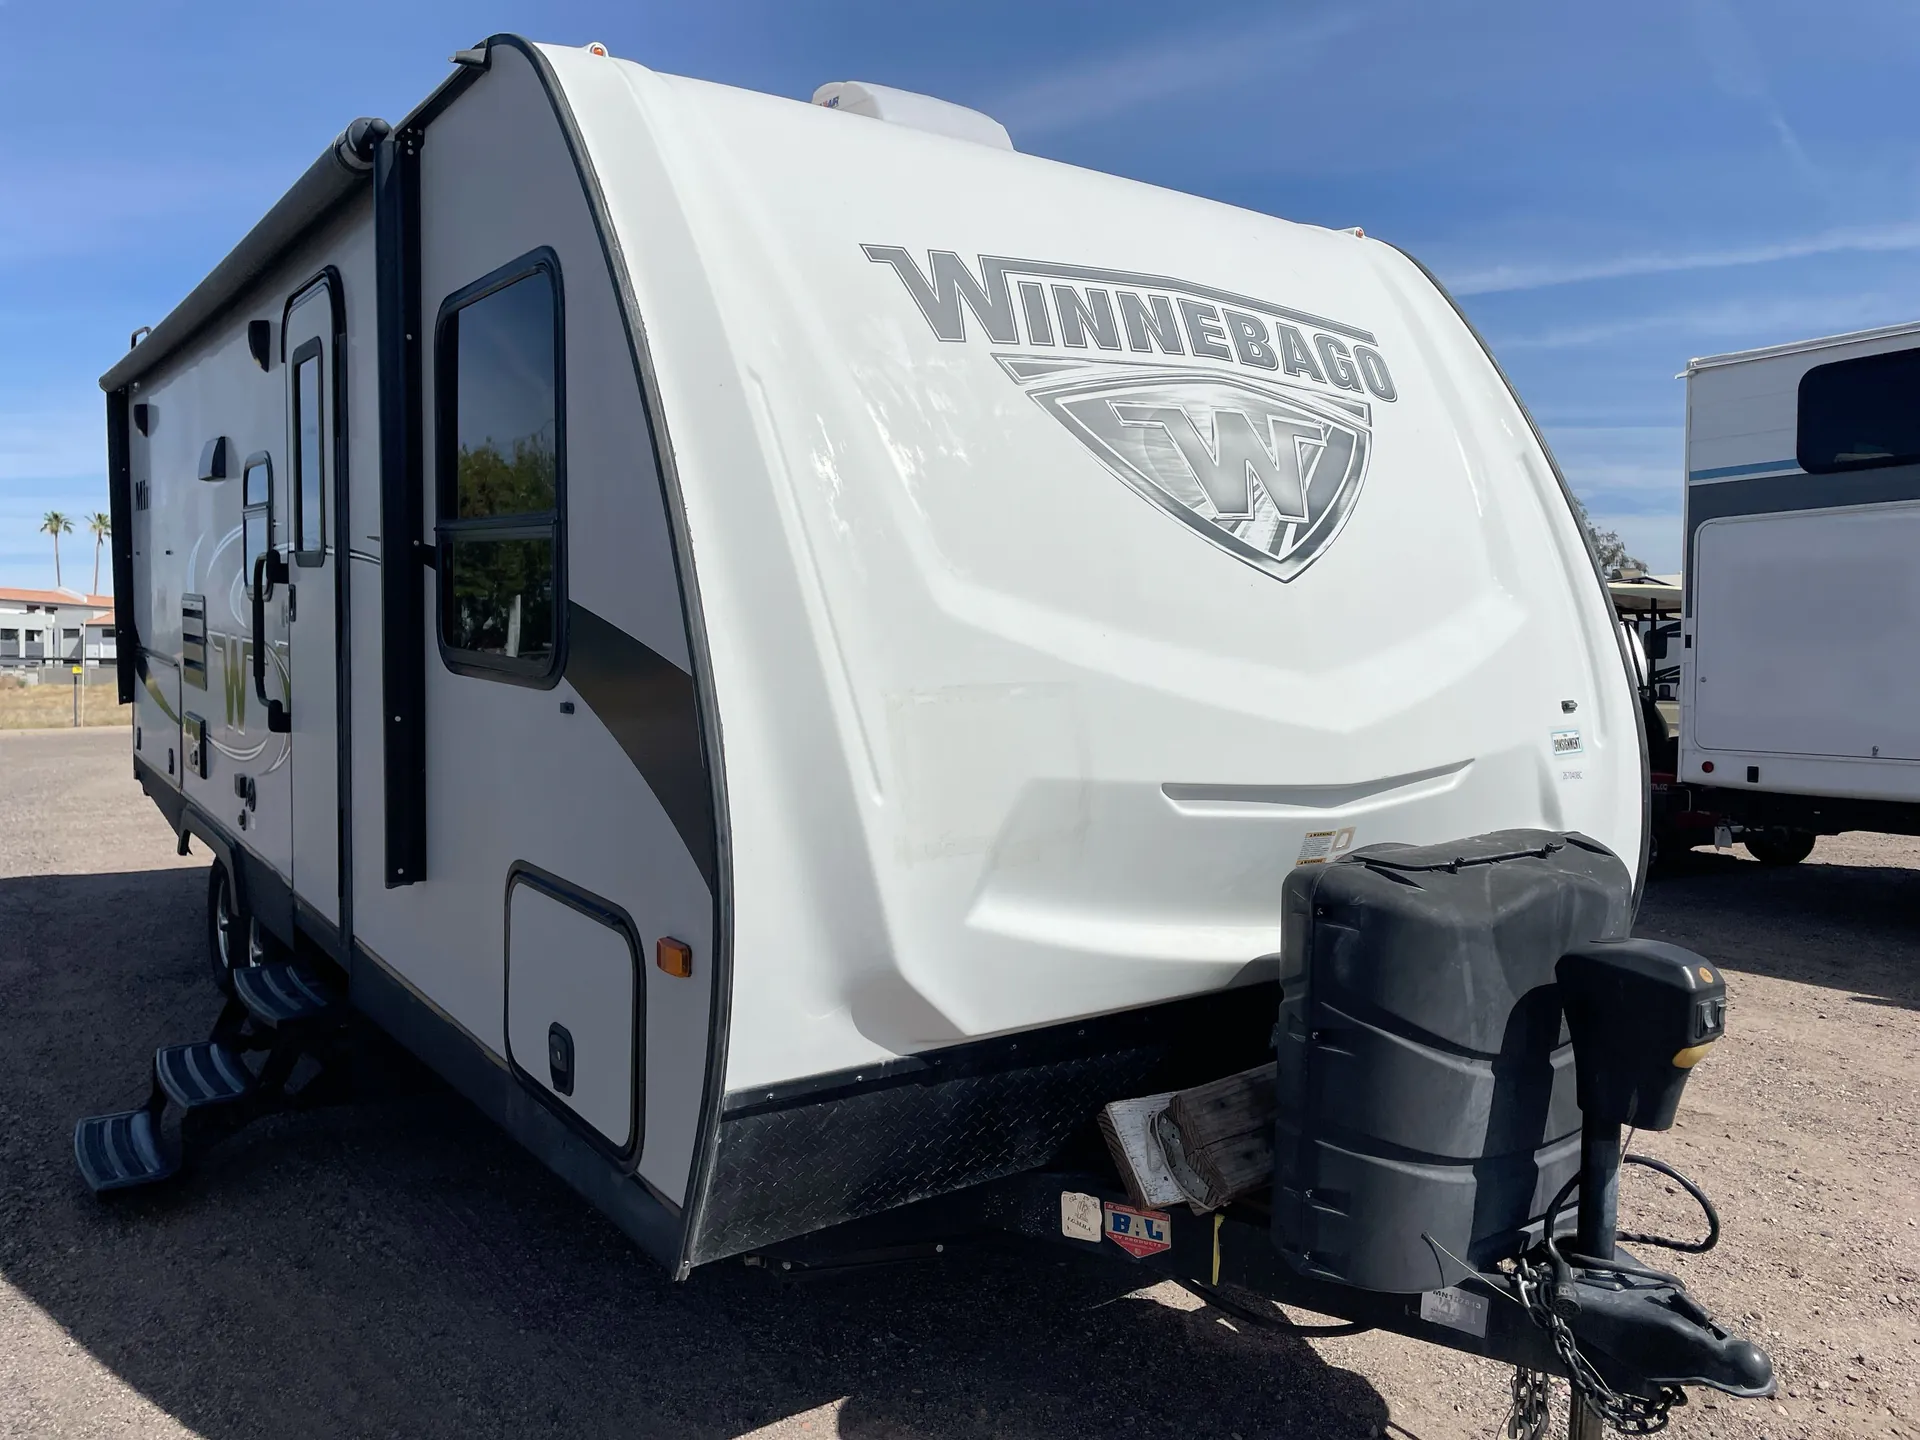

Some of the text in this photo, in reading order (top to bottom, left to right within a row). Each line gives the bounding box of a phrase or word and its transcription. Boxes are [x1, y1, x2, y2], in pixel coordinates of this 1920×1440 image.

[859, 244, 1397, 403] WINNEBAGO
[1105, 400, 1328, 522] W
[1111, 1212, 1164, 1241] BAL
[1124, 1236, 1161, 1248] PRODUCTS
